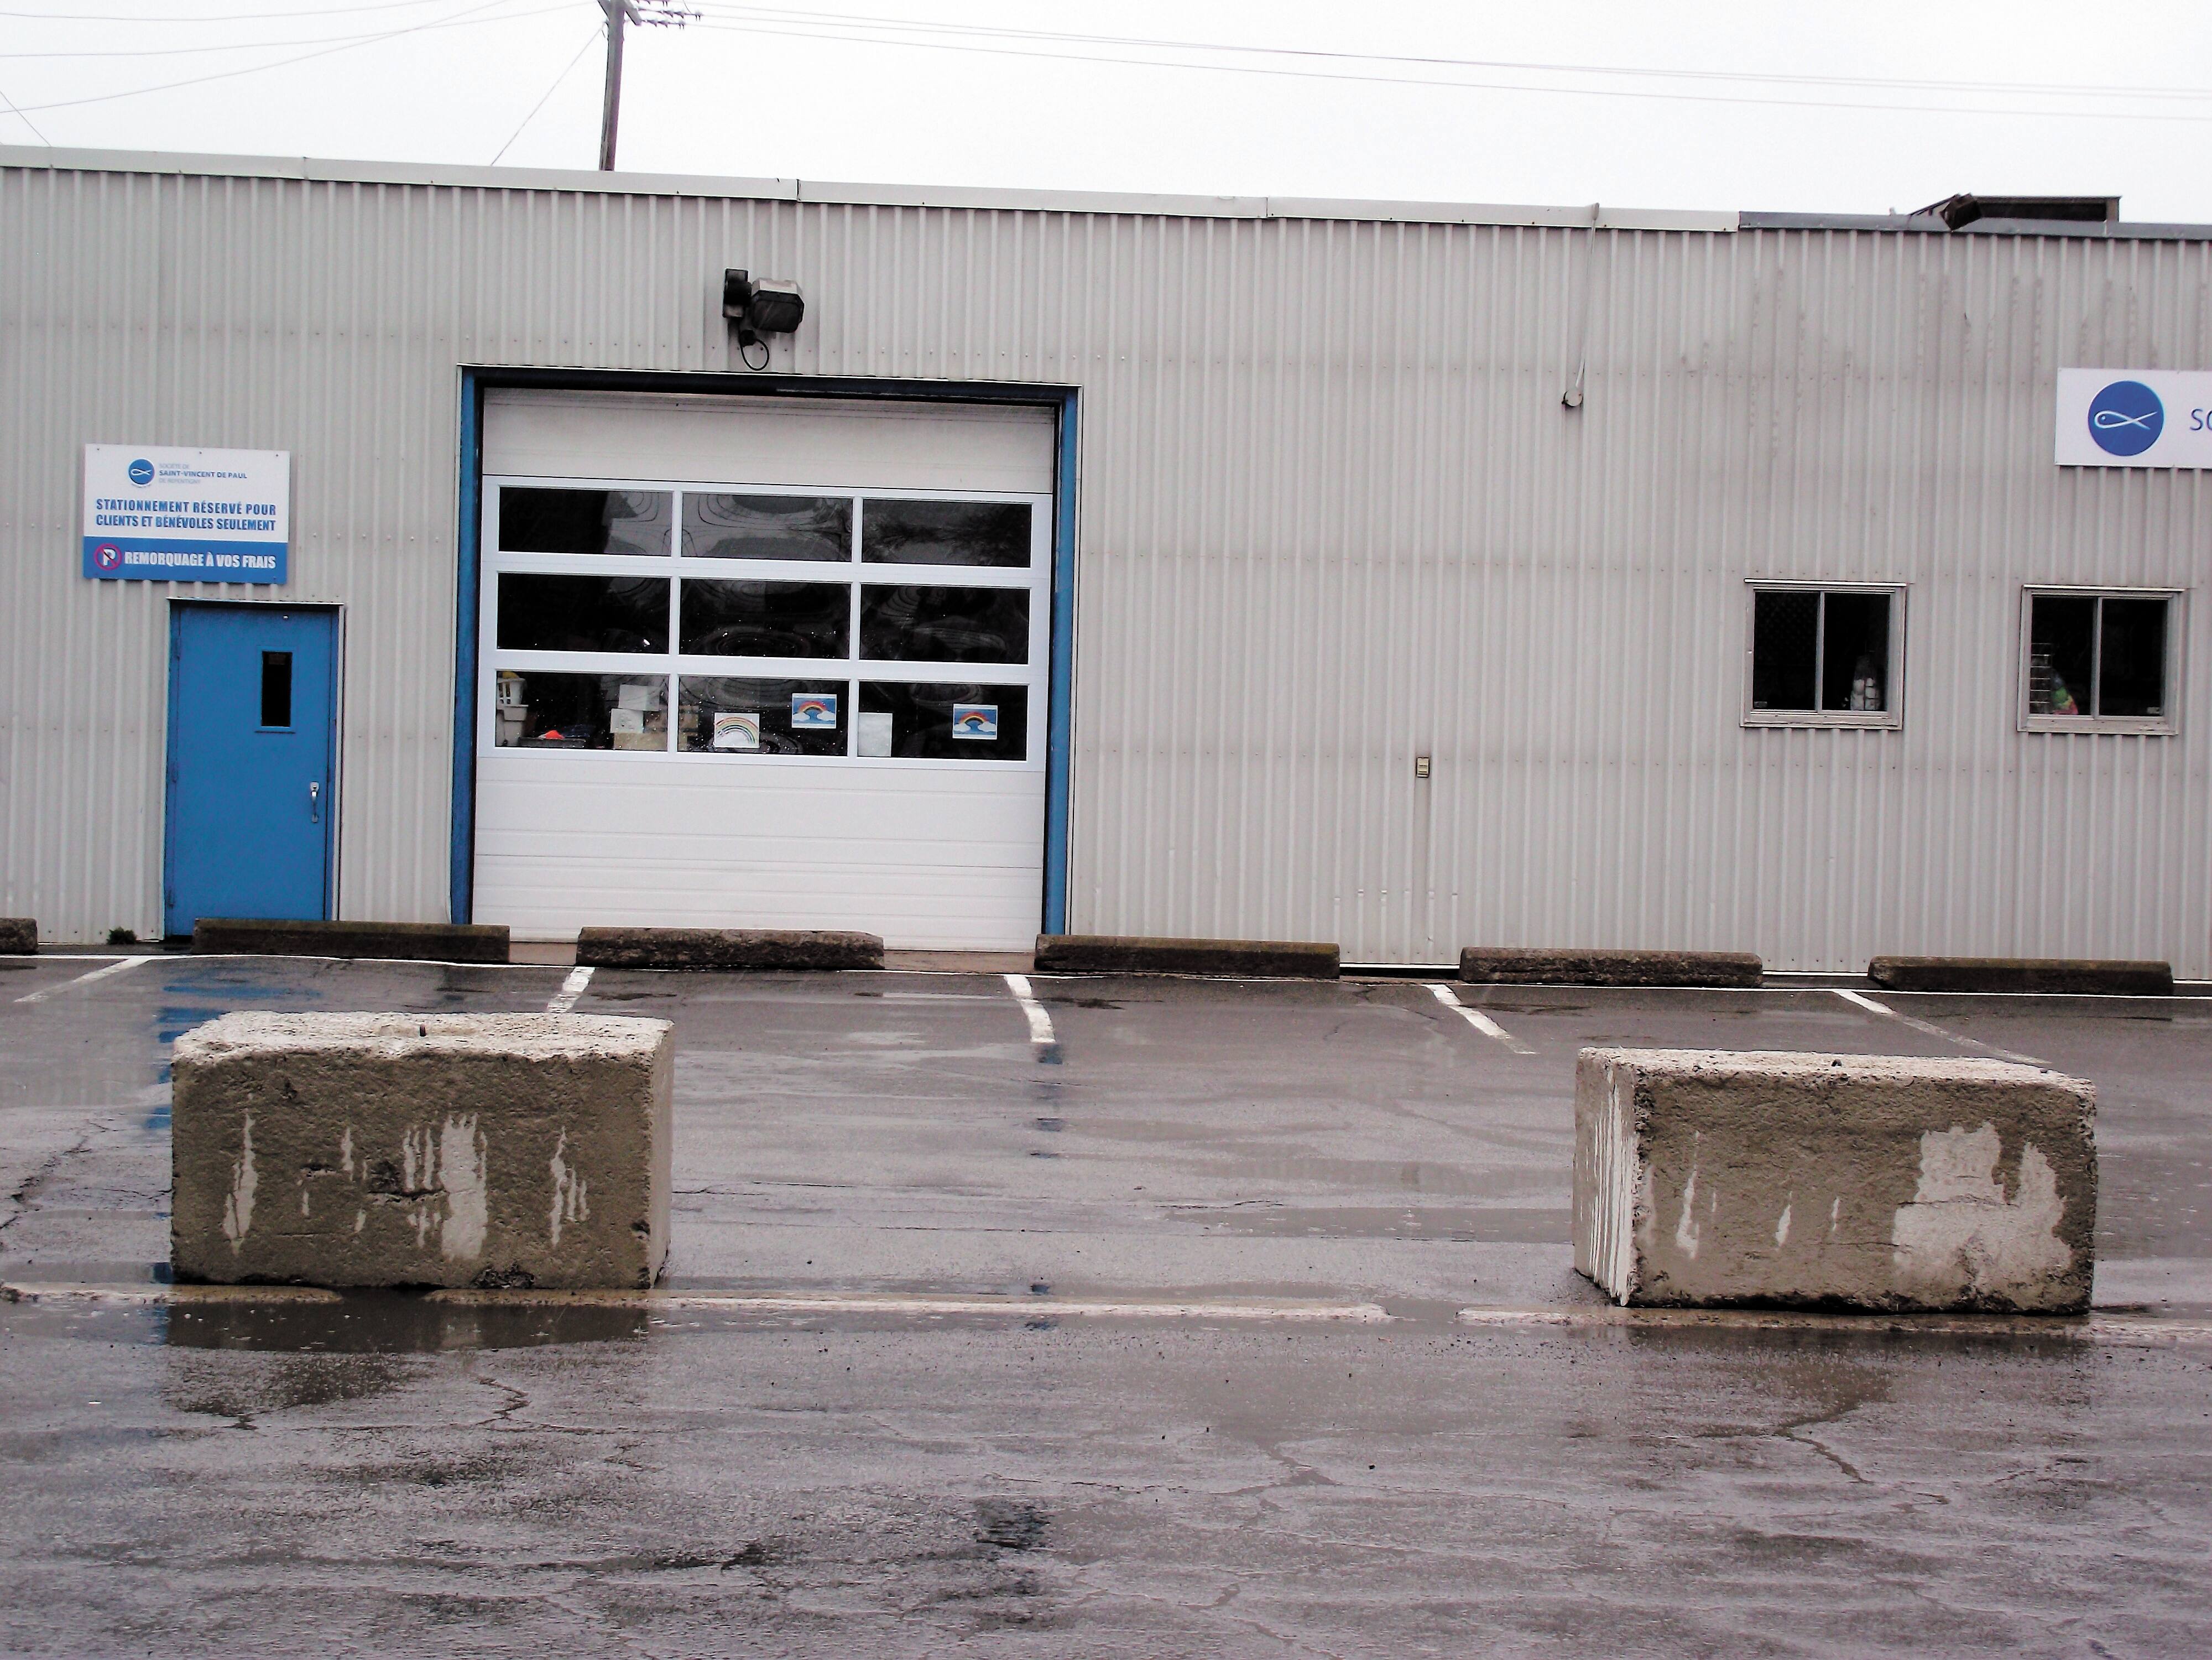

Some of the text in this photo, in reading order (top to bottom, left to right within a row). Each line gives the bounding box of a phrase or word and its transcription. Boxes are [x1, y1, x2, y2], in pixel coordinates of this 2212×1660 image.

[96, 498, 276, 515] STATIONNEMENT RÉSERVÉ POUR
[96, 514, 276, 530] CLIENTS ET BÉNÉVOLES SEULEMENT
[124, 551, 276, 569] REMORQUAGE À VOS FRAIS
